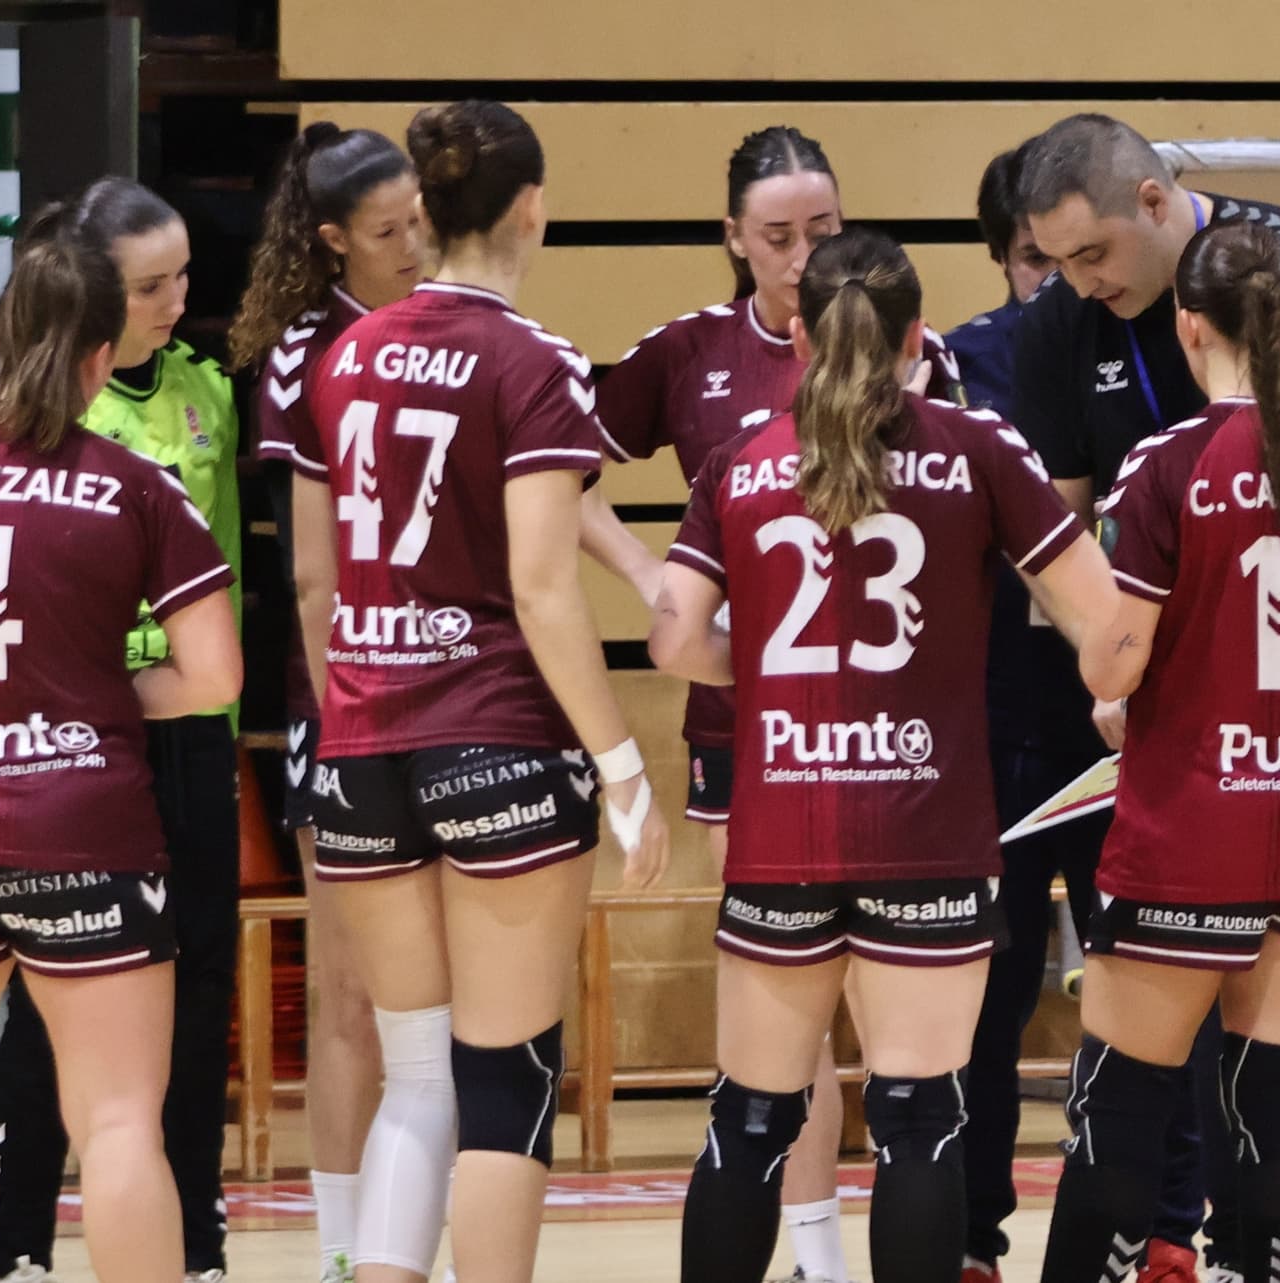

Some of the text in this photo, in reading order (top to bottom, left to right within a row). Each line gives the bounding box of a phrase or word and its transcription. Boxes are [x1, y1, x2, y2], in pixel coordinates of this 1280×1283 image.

[333, 341, 478, 388] A. GRAU
[337, 399, 460, 567] 47
[1190, 479, 1227, 516] C.
[754, 511, 927, 677] 23
[418, 758, 545, 804] LOUISIANA
[432, 793, 558, 842] Dissalud
[0, 903, 123, 937] Dissalud
[856, 891, 978, 921] Dissalud
[1137, 907, 1197, 928] FERROS
